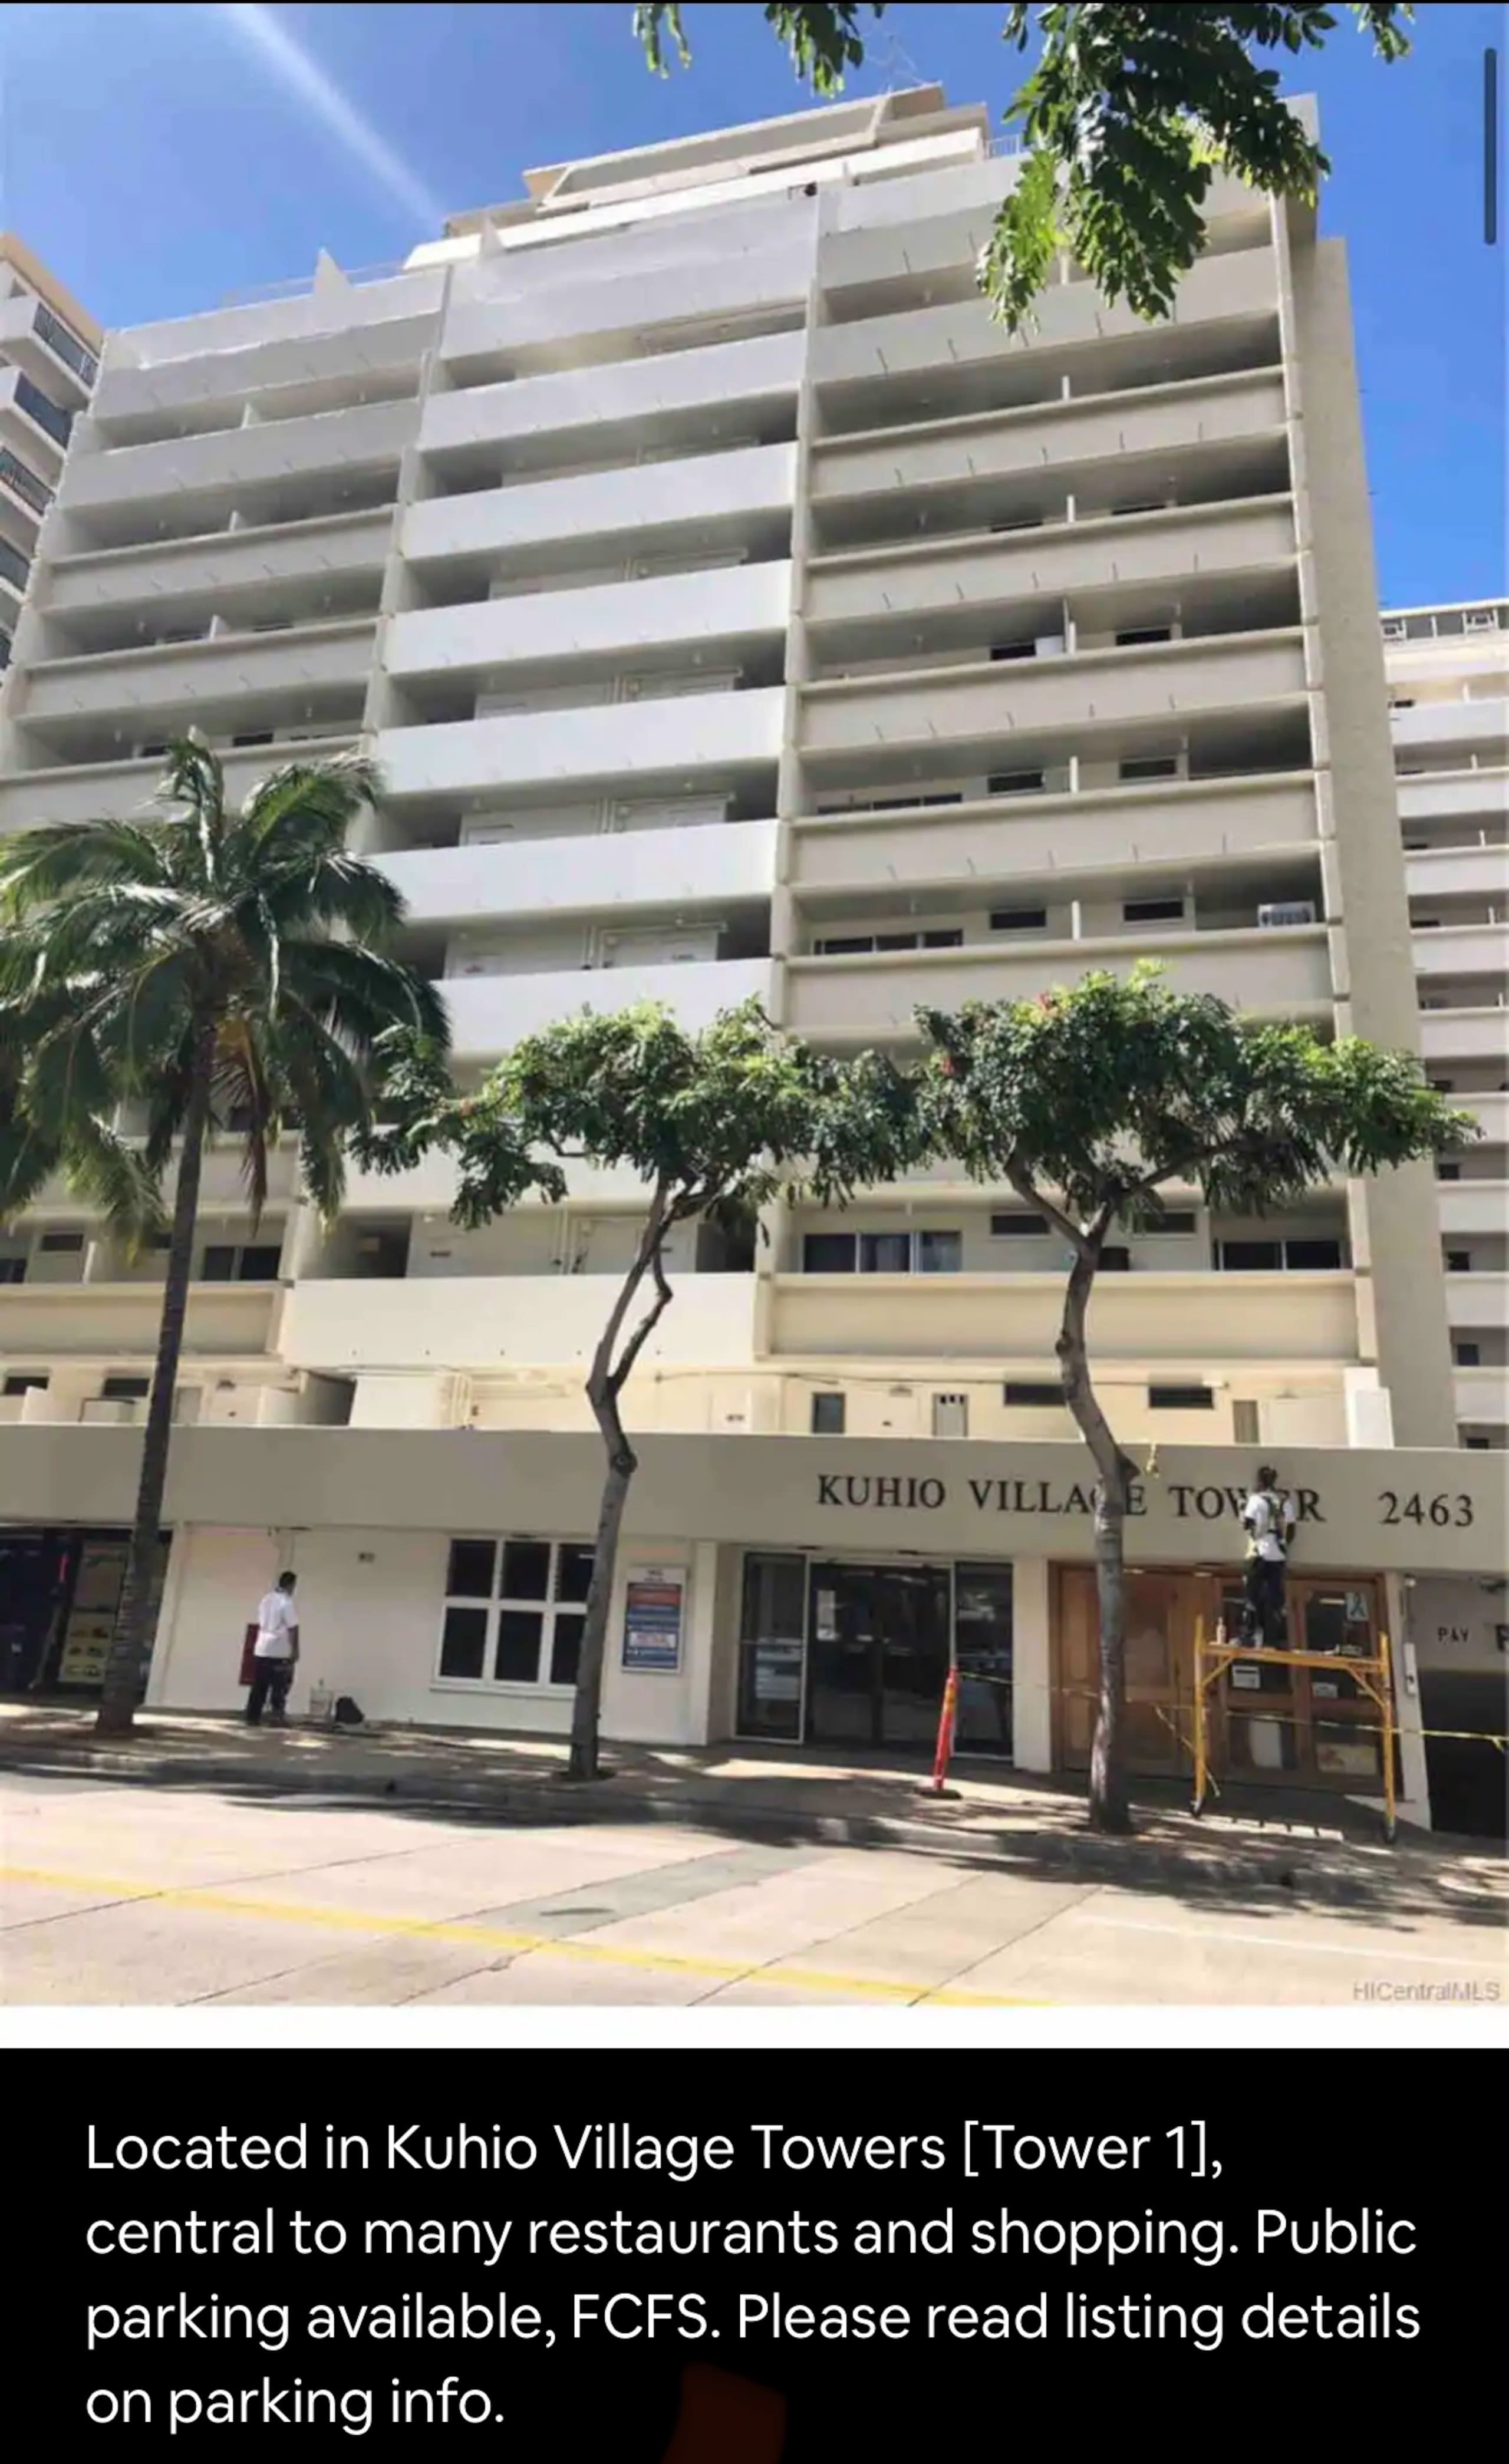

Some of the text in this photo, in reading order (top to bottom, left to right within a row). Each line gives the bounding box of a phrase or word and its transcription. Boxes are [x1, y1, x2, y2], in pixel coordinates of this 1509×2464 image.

[817, 1475, 1474, 1527] KUHIO VILLAE TOWR 2463
[1437, 1626, 1469, 1643] PAY
